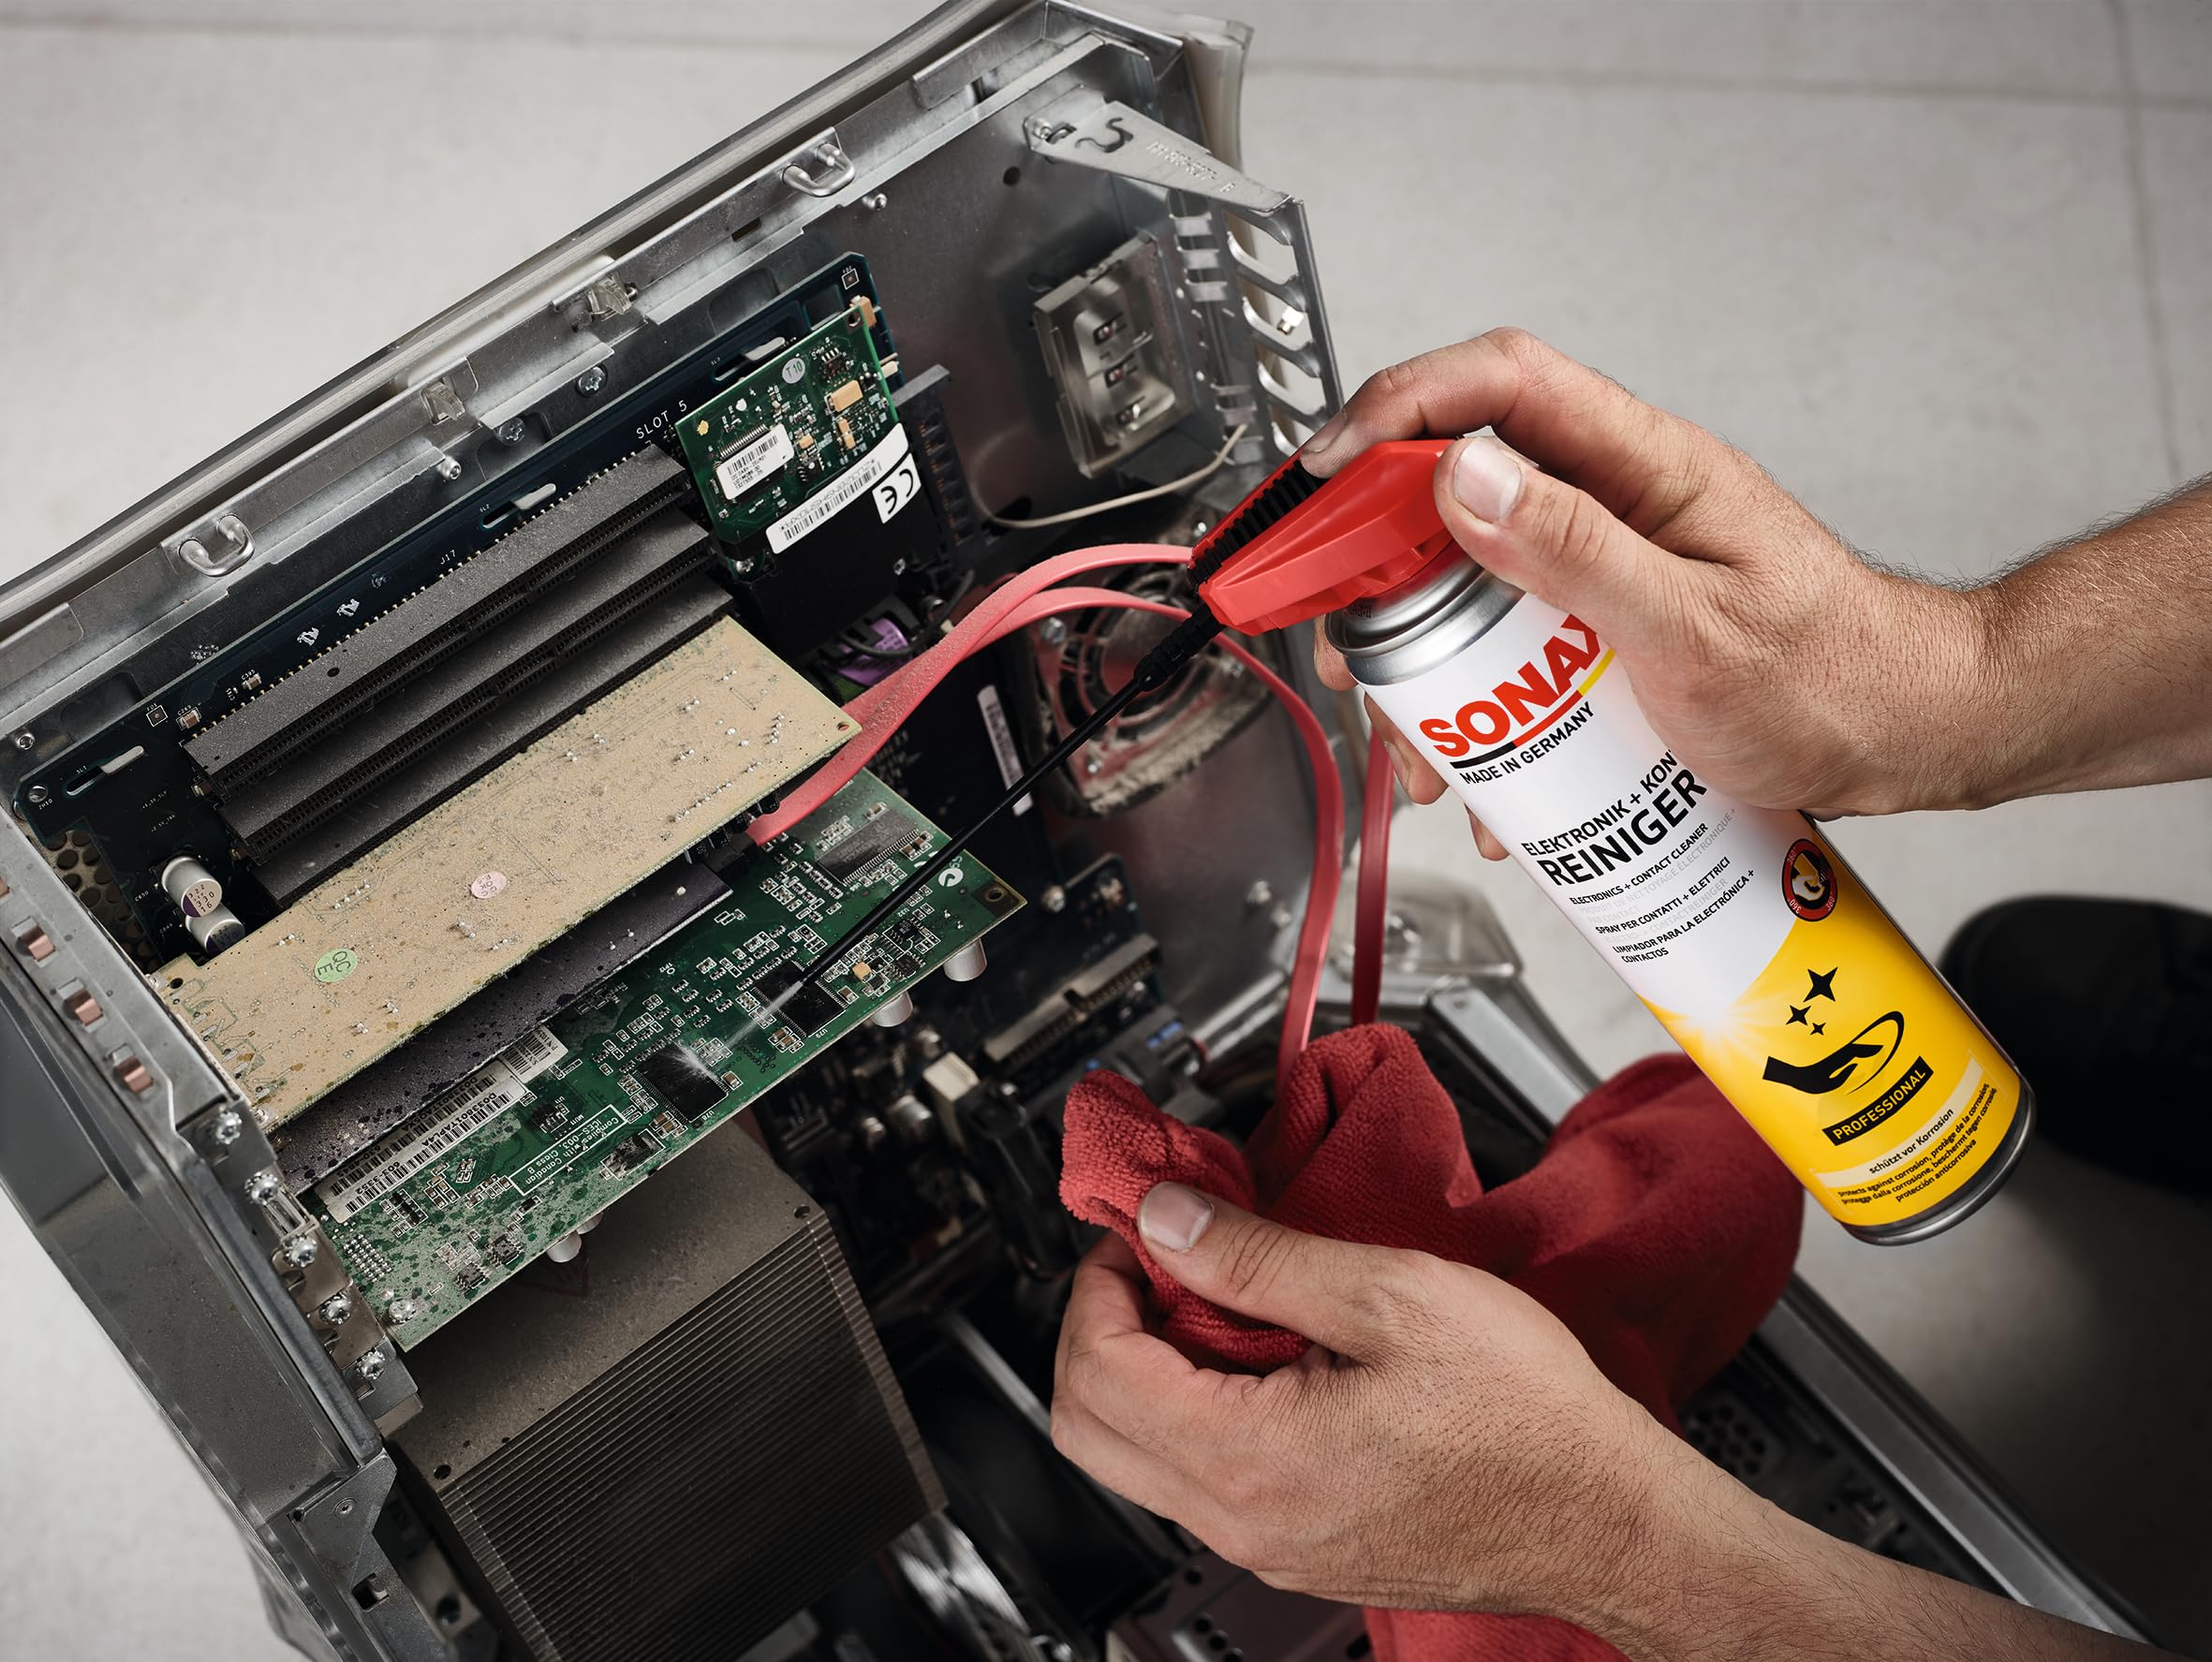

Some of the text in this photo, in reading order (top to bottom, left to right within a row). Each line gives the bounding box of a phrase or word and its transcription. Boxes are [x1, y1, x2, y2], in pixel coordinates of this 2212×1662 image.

[637, 400, 687, 439] SLOT 5
[440, 549, 456, 566] J17
[1419, 613, 1600, 757] SONAX
[1459, 701, 1594, 785] MADE IN GERMANY
[1521, 749, 1678, 856] ELEKTRONIK + KON
[1537, 769, 1707, 886] REINIGER
[1569, 885, 1624, 905] ELECTRONICS
[1630, 856, 1672, 887] CONTACT
[1671, 822, 1708, 860] CLEANER
[1627, 869, 1678, 903] NETTOYAGE
[1676, 813, 1732, 872] ÉLECTRONIQUE
[1596, 925, 1622, 934] SPRAY
[1620, 919, 1639, 931] PER
[1638, 897, 1682, 925] CONTATTI
[1688, 856, 1731, 897] ELETTRICI
[1613, 869, 1755, 953] LIMPIADOR PARA LA ELECTRÓNICA +
[332, 951, 351, 972] QC
[1620, 947, 1669, 963] CONTACTOS
[421, 1092, 496, 1147] D033801TAPL4A
[1832, 1069, 1926, 1140] PROFESSIONAL
[525, 1117, 619, 1185] Complies with Canadian
[526, 1167, 536, 1175] B
[536, 1150, 559, 1167] Class
[1866, 1176, 1895, 1193] against
[1894, 1155, 1932, 1180] corrosion,
[1930, 1132, 1957, 1159] protège
[1955, 1123, 1965, 1134] de
[1963, 1114, 1970, 1125] la
[1869, 1109, 1954, 1174] schützt vor Korrosion
[1872, 1185, 1892, 1199] dalla
[1892, 1165, 1934, 1193] corrosione,
[1932, 1134, 1969, 1169] beschermt
[1967, 1114, 1983, 1139] tegen
[1895, 1139, 1977, 1202] protección anticorrosiva
[356, 1161, 401, 1195] 603-3352
